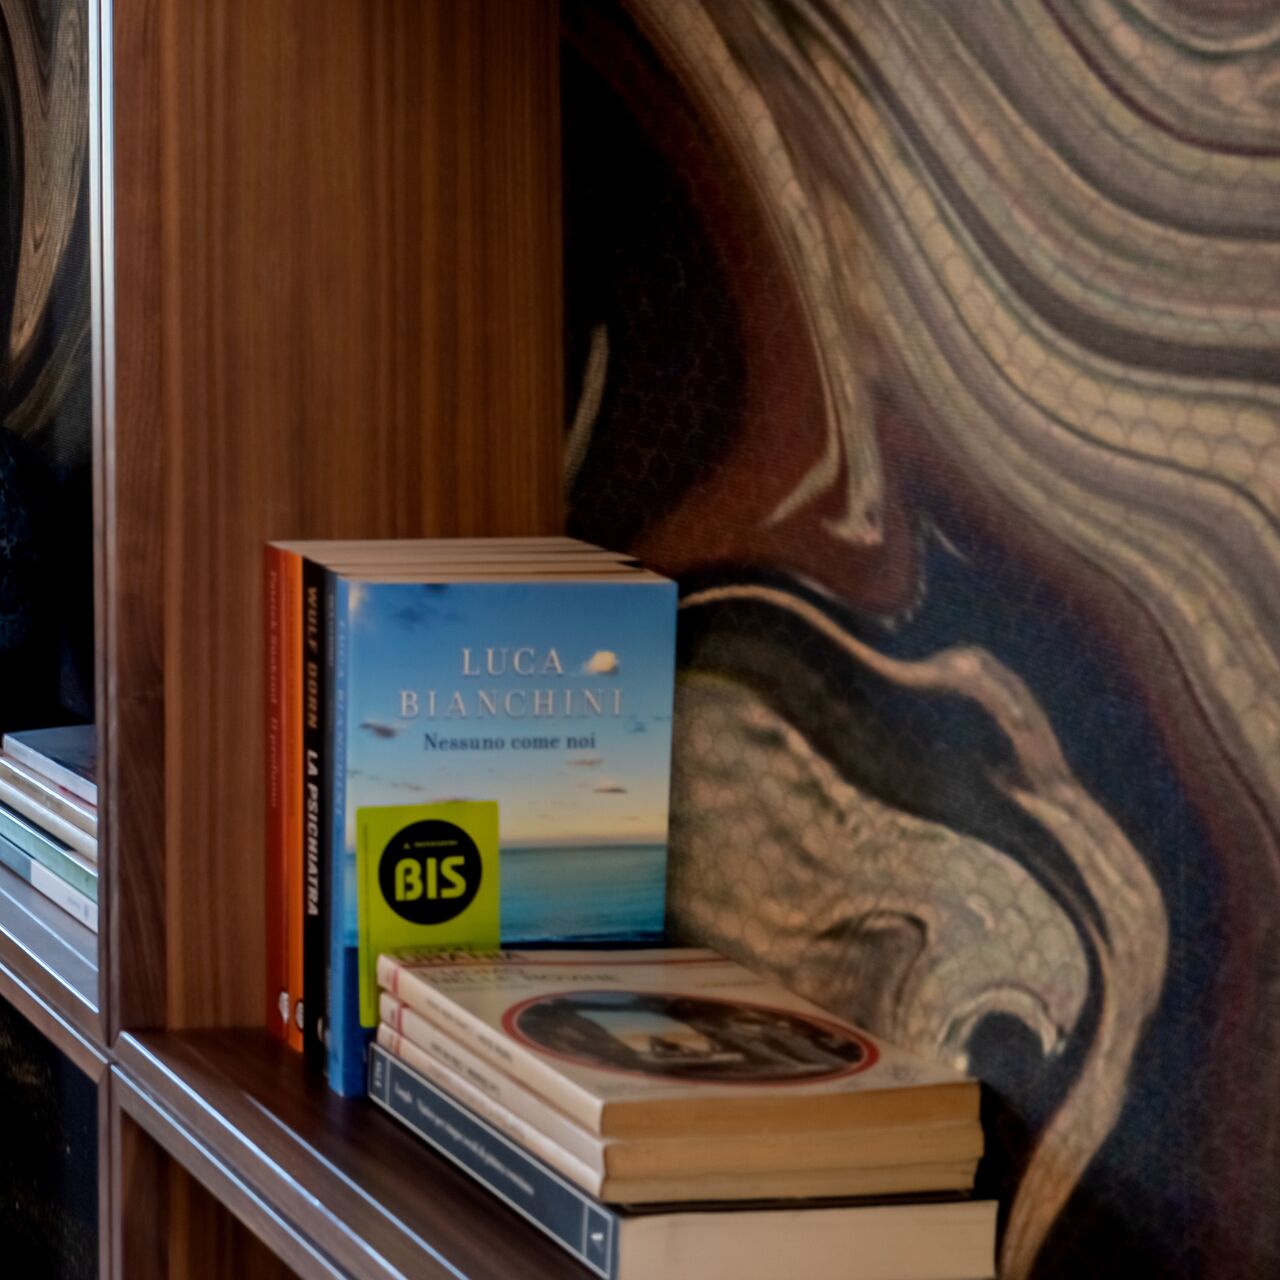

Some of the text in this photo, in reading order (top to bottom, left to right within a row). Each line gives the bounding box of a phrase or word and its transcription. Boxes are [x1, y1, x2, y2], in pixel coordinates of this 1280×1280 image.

[307, 586, 318, 730] WULF DORN
[461, 646, 565, 677] LUCA
[399, 687, 623, 718] BIANCHINI
[423, 731, 597, 752] Nessuno come noi
[307, 749, 318, 916] LA PSICHIATRA
[394, 855, 467, 902] BIS
